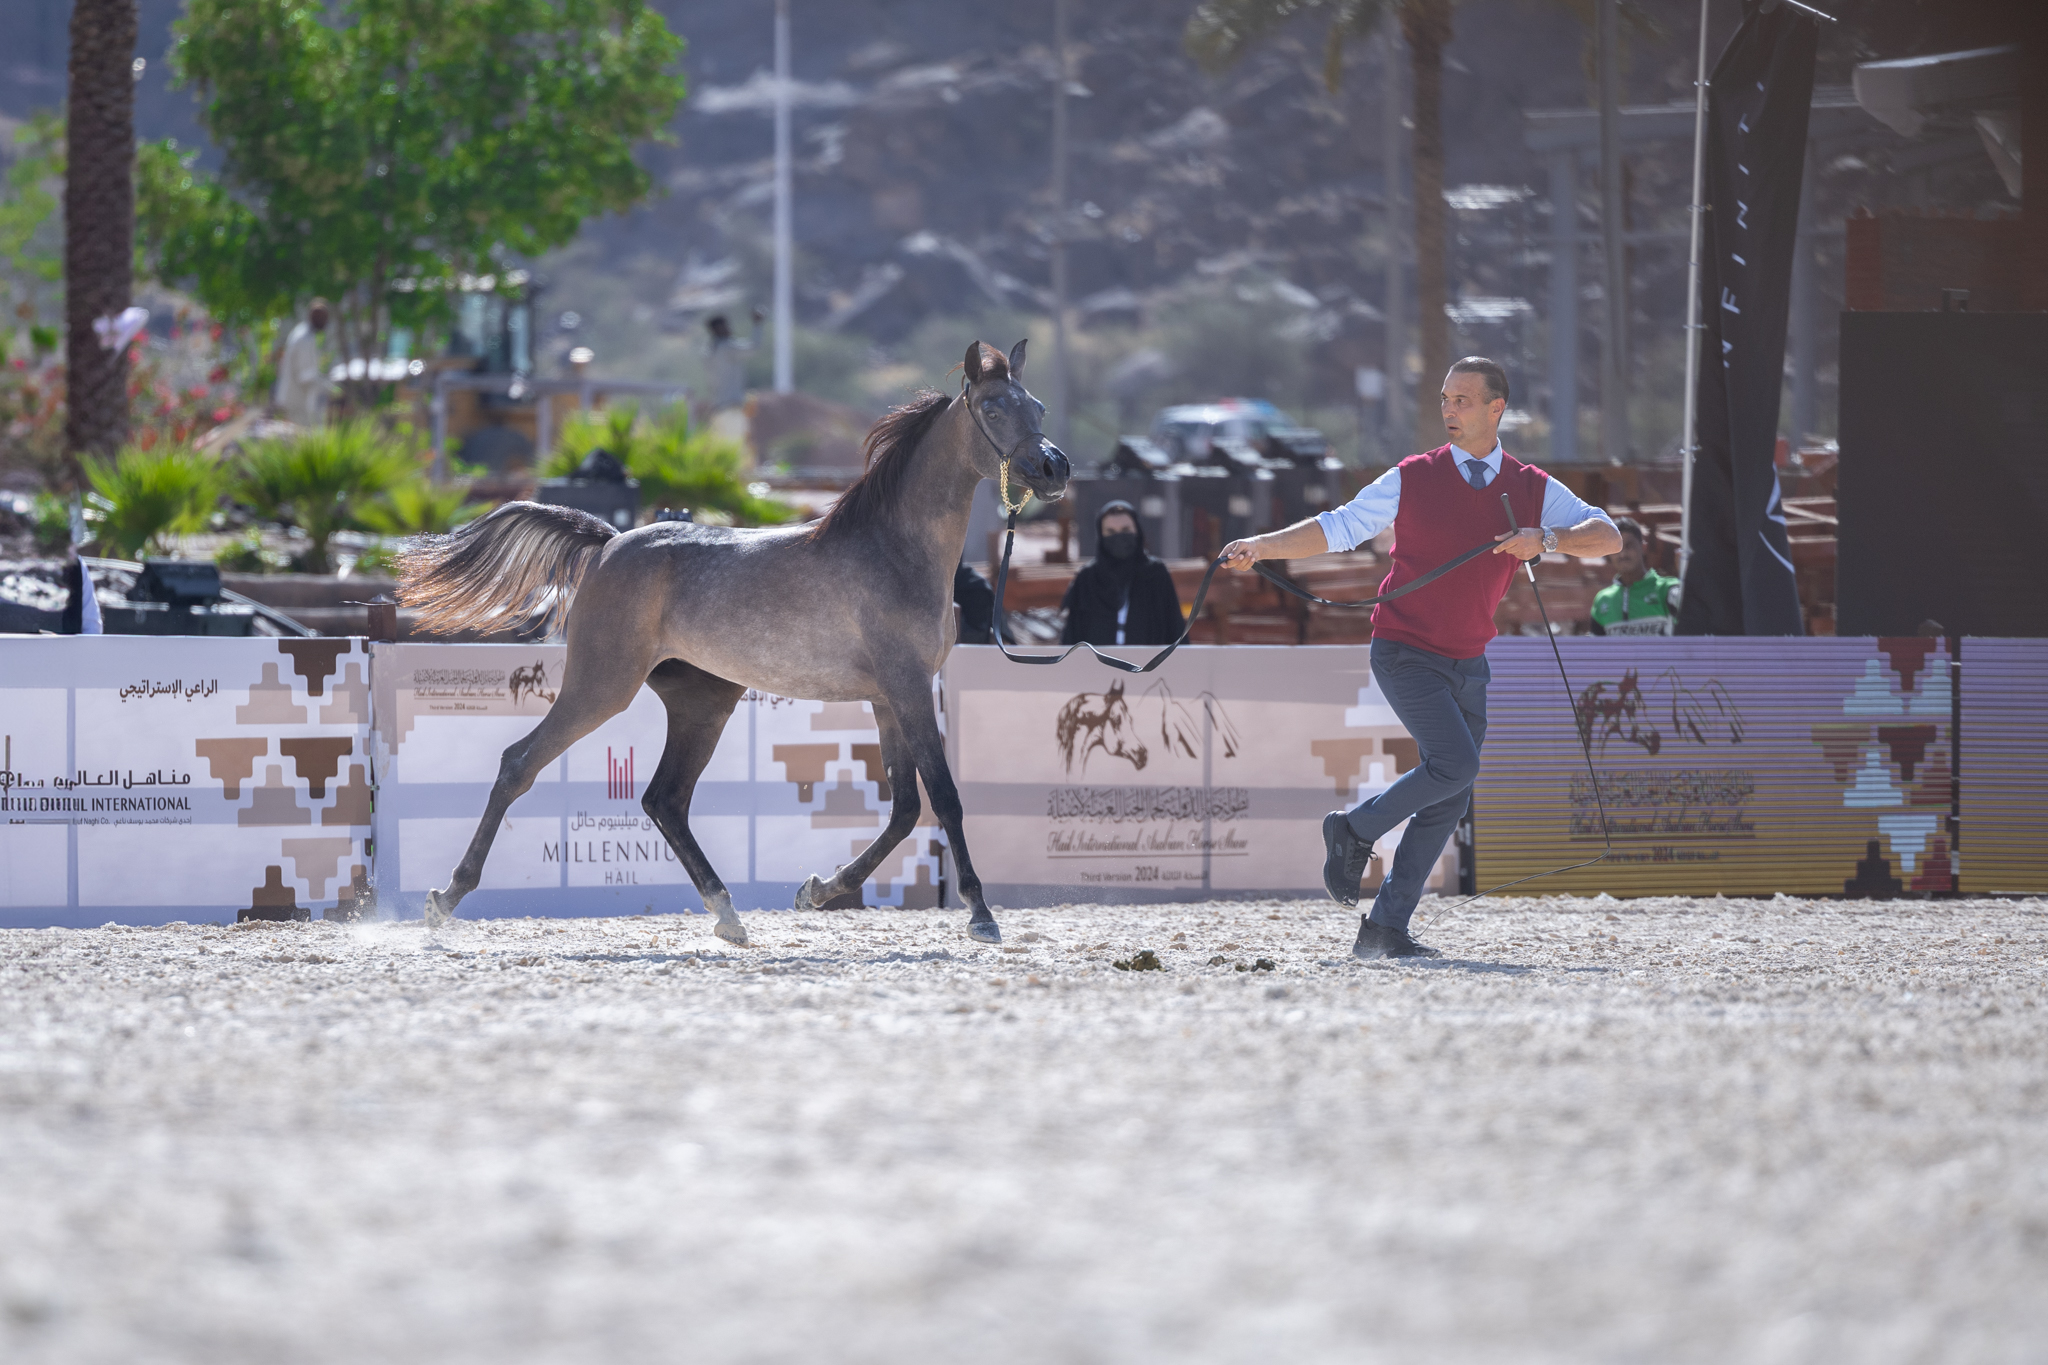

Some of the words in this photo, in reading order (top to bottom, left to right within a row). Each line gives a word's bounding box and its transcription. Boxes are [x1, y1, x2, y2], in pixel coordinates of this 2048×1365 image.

[185, 679, 218, 702] الراعي
[123, 769, 191, 789] مناهل
[91, 797, 191, 811] INTERNATIONAL
[100, 817, 111, 825] Co.
[542, 840, 677, 863] MILLENNIU
[605, 870, 639, 885] HAIL
[1135, 866, 1159, 881] 2024
